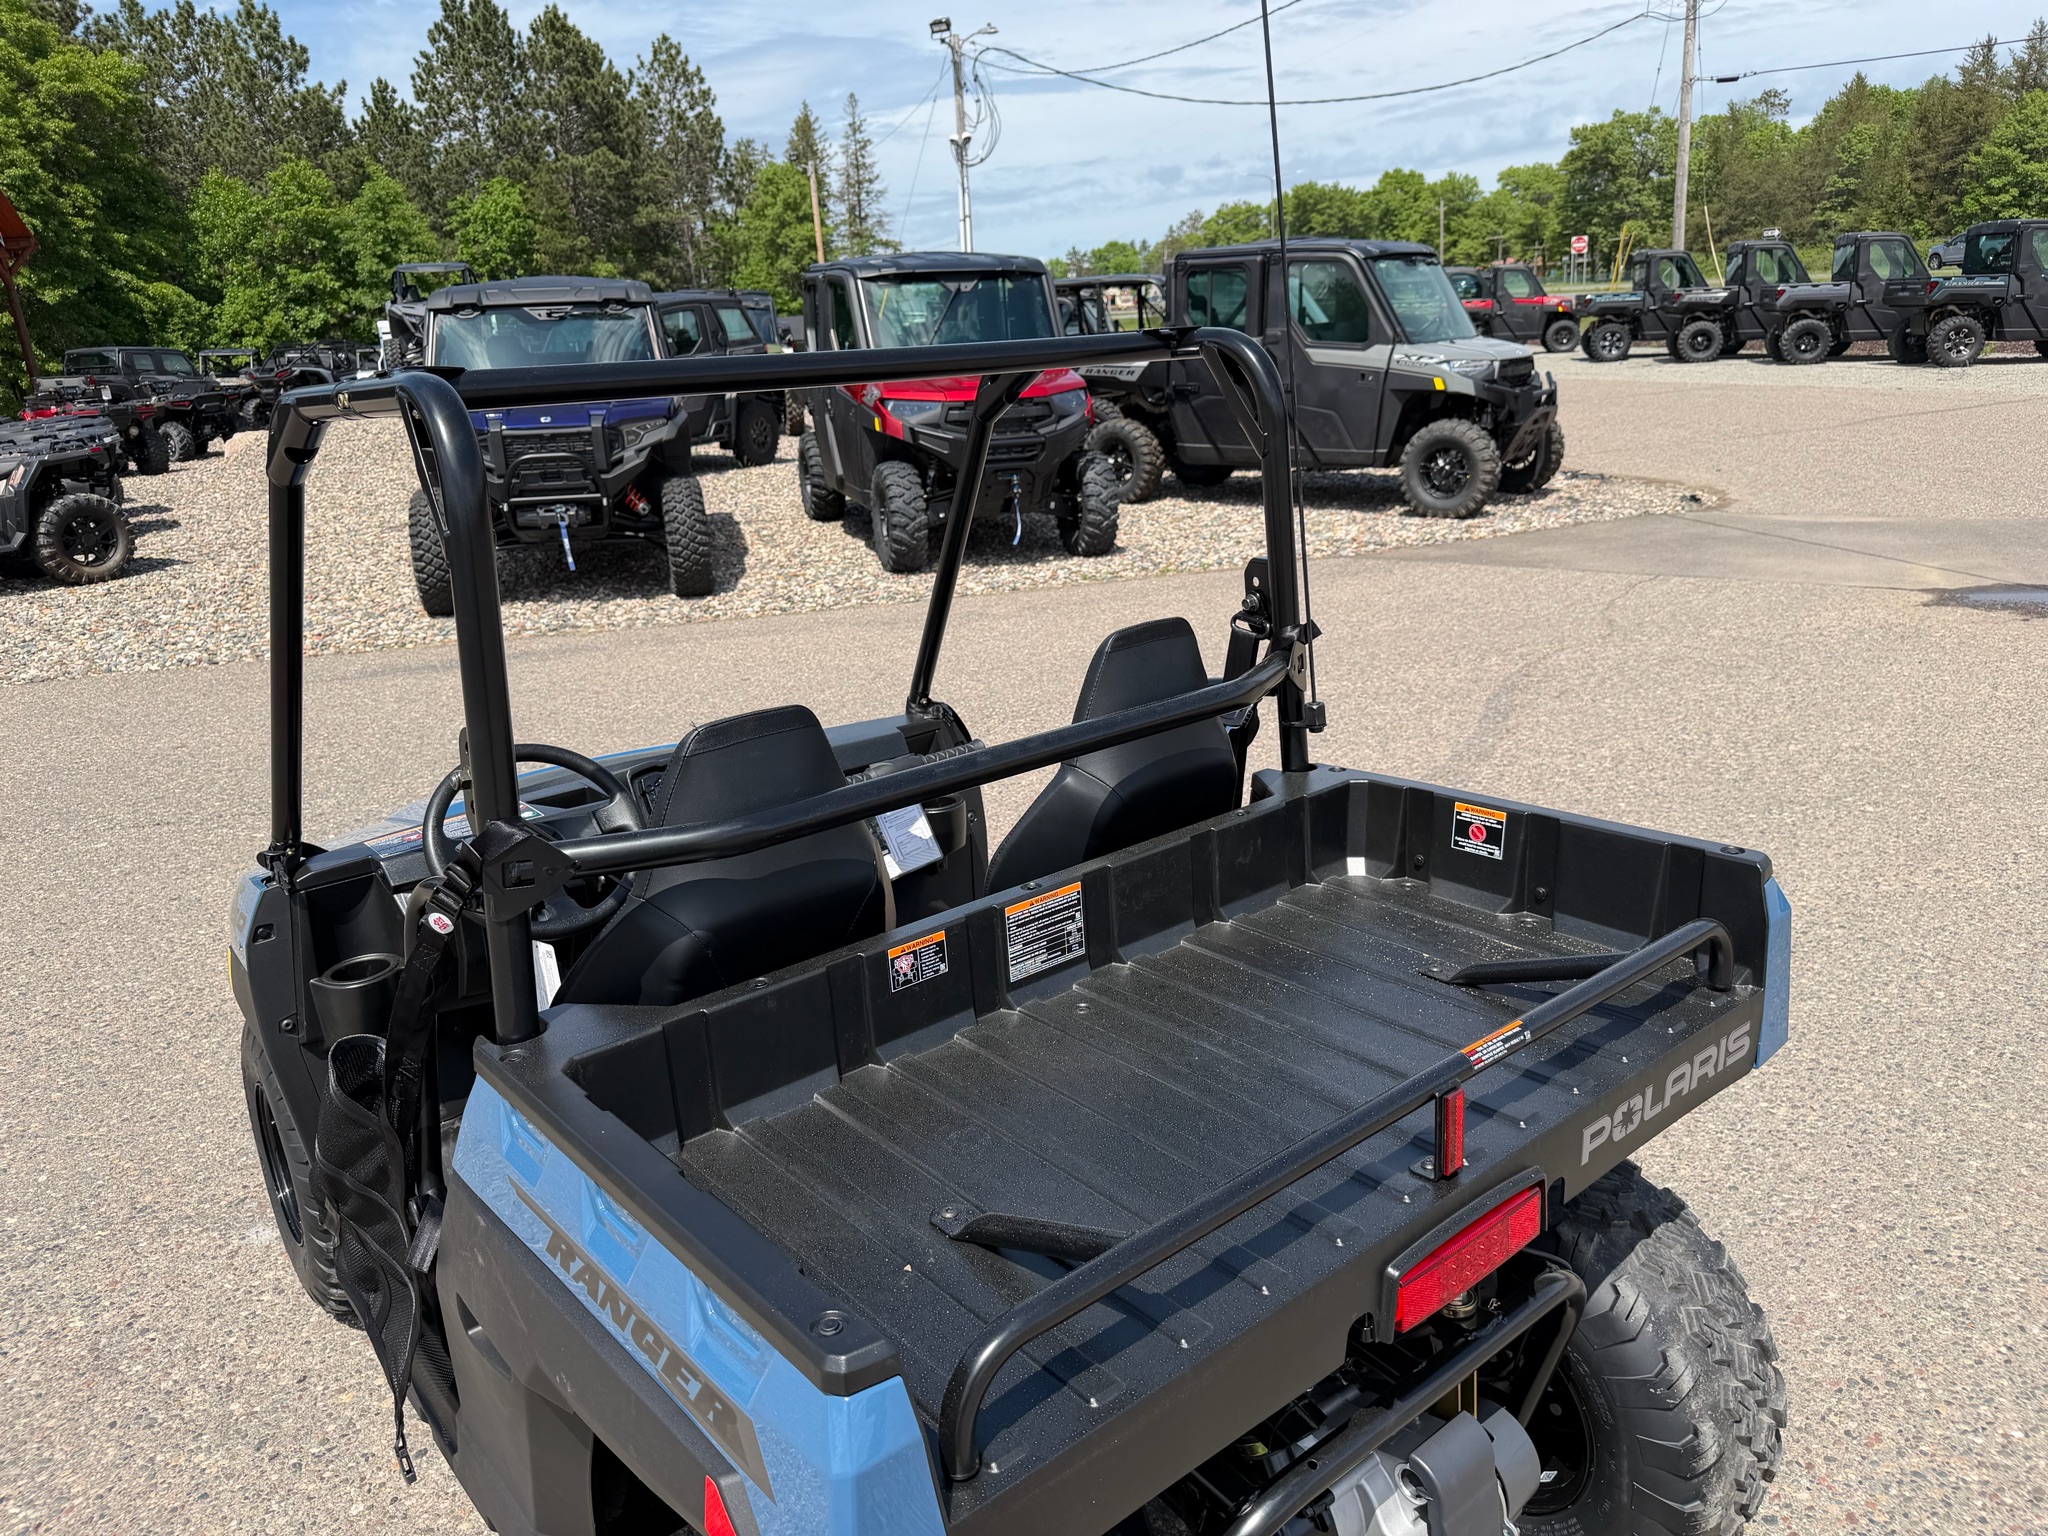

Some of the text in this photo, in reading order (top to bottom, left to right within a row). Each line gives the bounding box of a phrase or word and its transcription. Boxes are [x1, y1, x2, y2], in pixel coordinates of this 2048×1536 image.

[1085, 368, 1135, 376] RANGER
[1470, 806, 1496, 818] WARNING
[1034, 891, 1060, 905] WARNING
[906, 936, 934, 951] WARNING
[1580, 1021, 1751, 1167] POLARIS
[544, 1228, 740, 1438] RANGER
